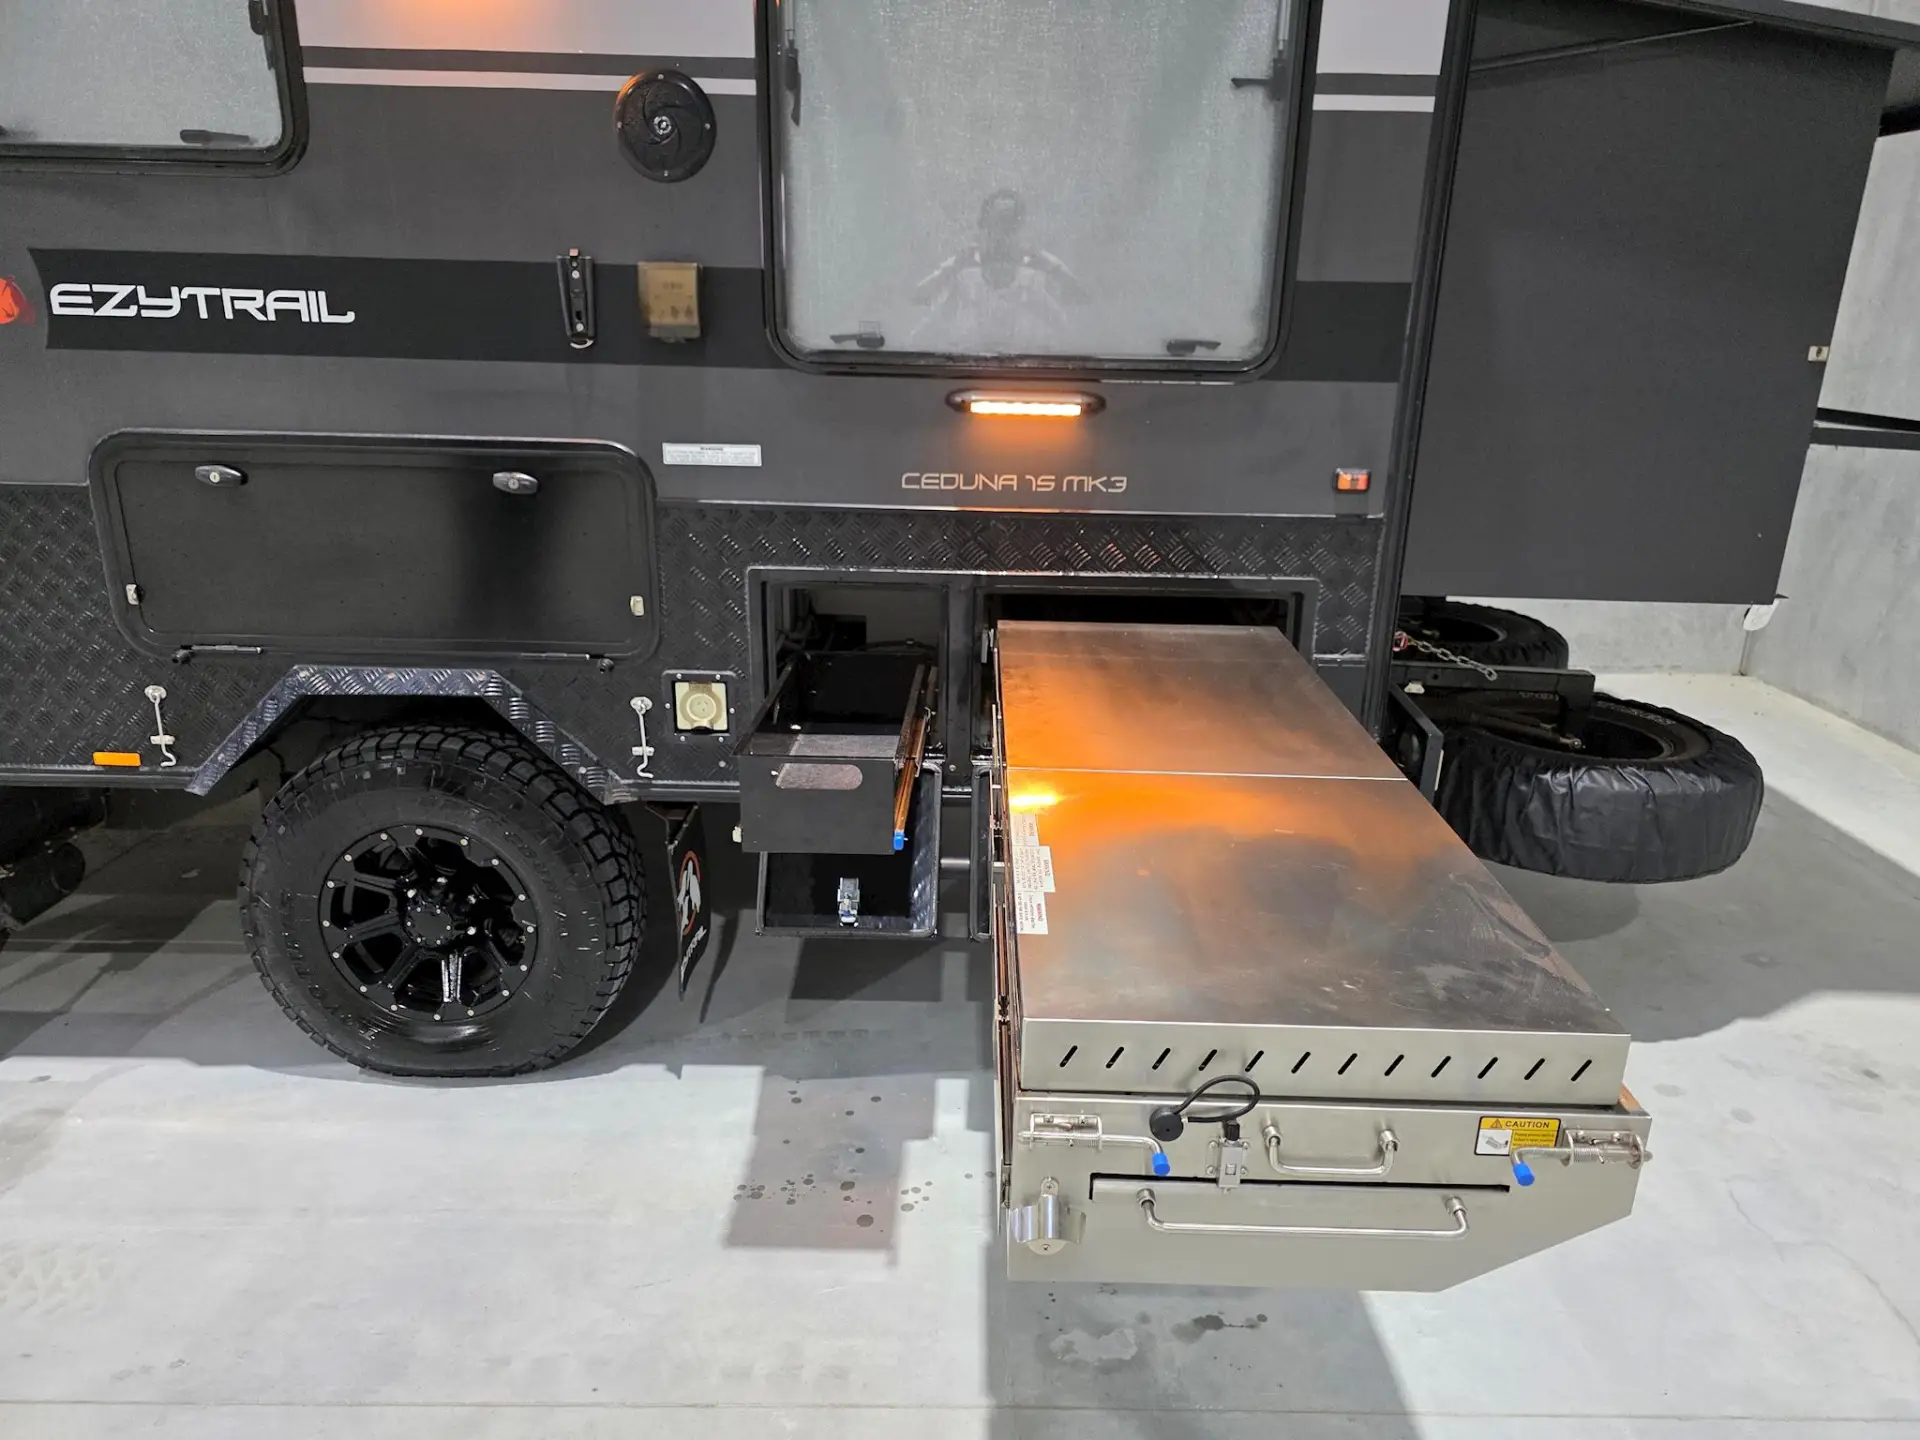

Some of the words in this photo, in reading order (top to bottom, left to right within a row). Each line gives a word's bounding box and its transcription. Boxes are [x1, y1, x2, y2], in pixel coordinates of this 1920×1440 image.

[50, 283, 355, 323] EZYTRAIL
[901, 472, 1018, 492] CEDUNA
[1062, 475, 1128, 493] MK3
[1505, 1120, 1550, 1128] CAUTION
